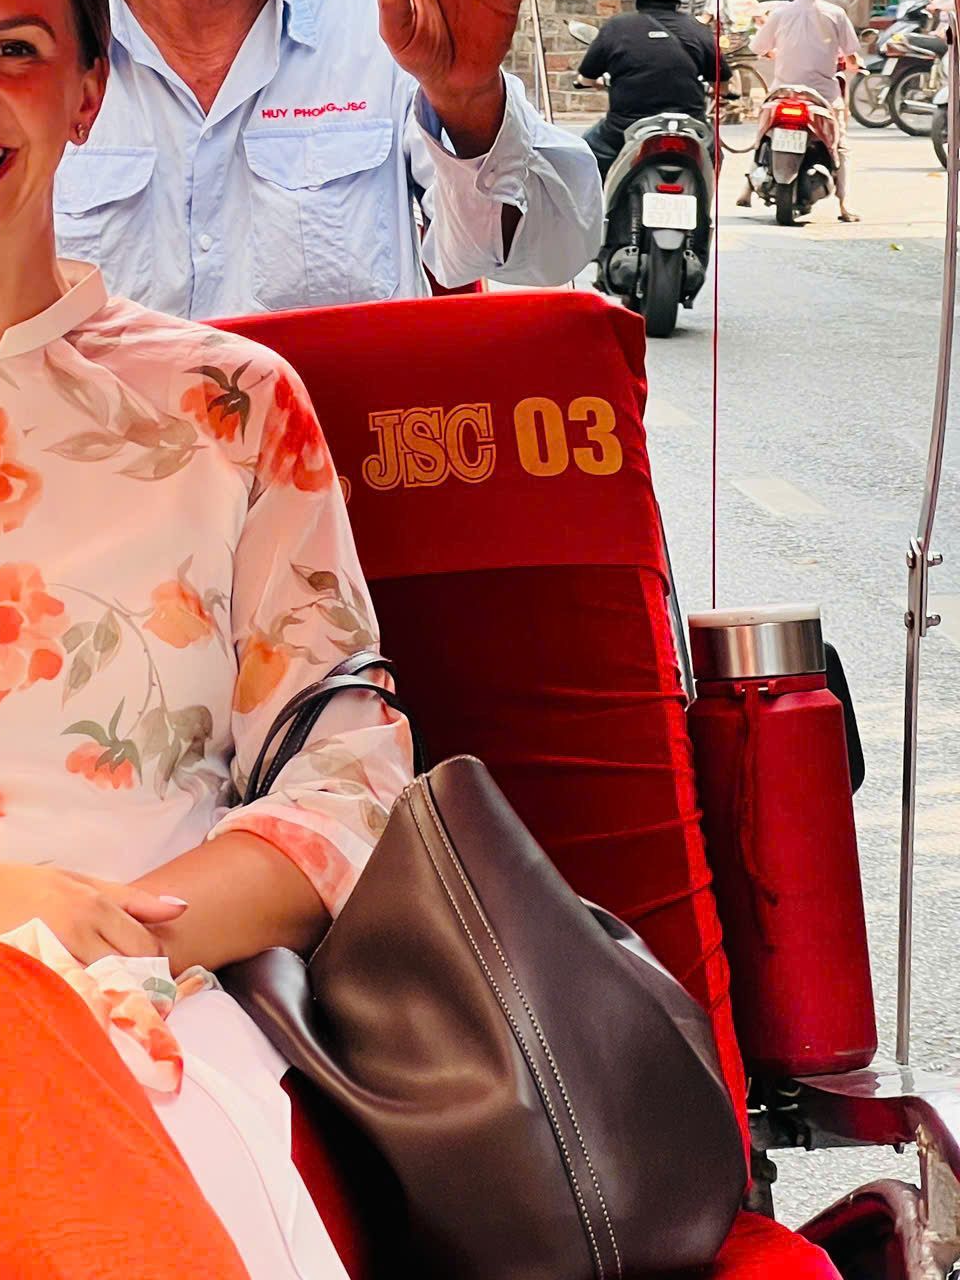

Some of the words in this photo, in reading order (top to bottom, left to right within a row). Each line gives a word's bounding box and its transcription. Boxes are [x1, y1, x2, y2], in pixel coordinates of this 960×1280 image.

[262, 108, 288, 119] HUY
[362, 403, 497, 491] JSC
[514, 397, 624, 477] 03
